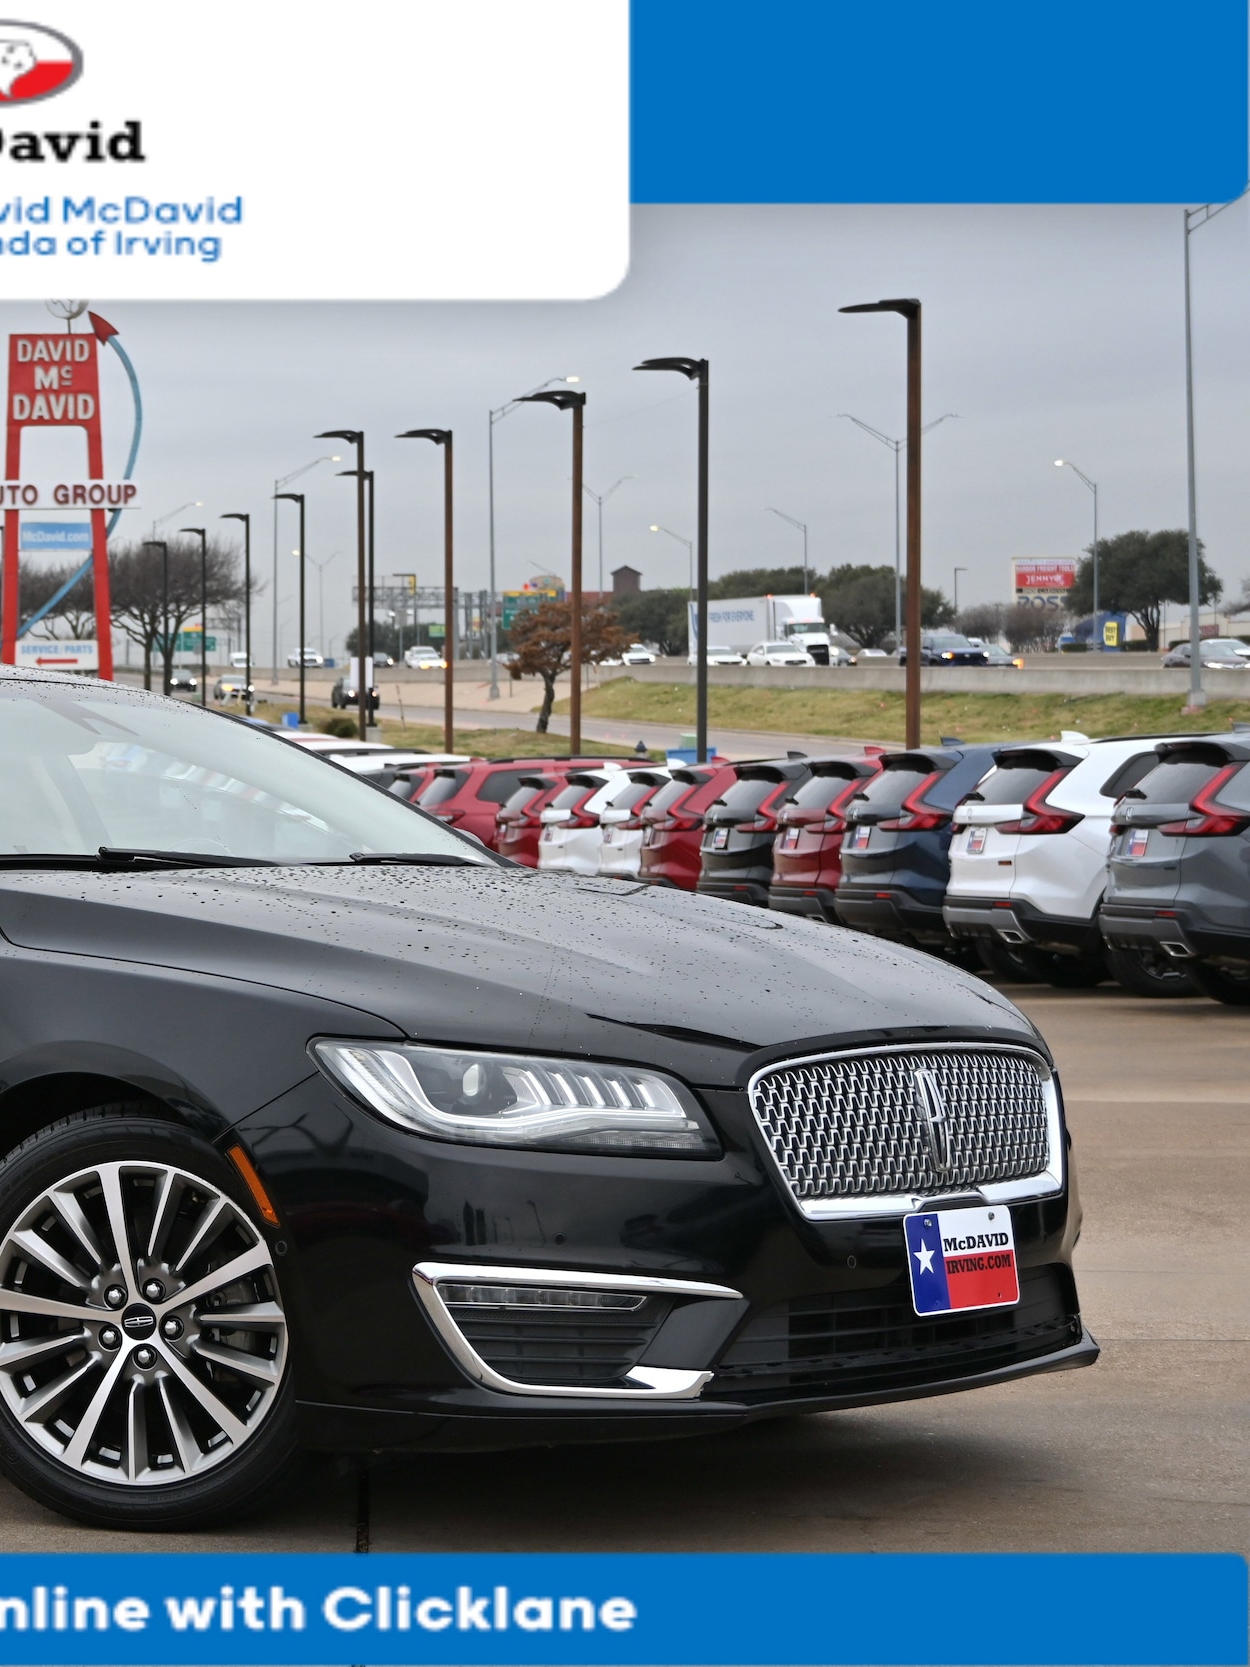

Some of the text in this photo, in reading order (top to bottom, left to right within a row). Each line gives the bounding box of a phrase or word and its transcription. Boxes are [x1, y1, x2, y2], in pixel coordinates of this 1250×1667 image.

[17, 338, 90, 362] DAVID
[12, 393, 95, 420] DAVID
[53, 484, 137, 506] GROUP
[22, 530, 89, 543] McDavid.com
[943, 1232, 1009, 1252] McDAVID
[946, 1254, 1012, 1275] IRVING.COM
